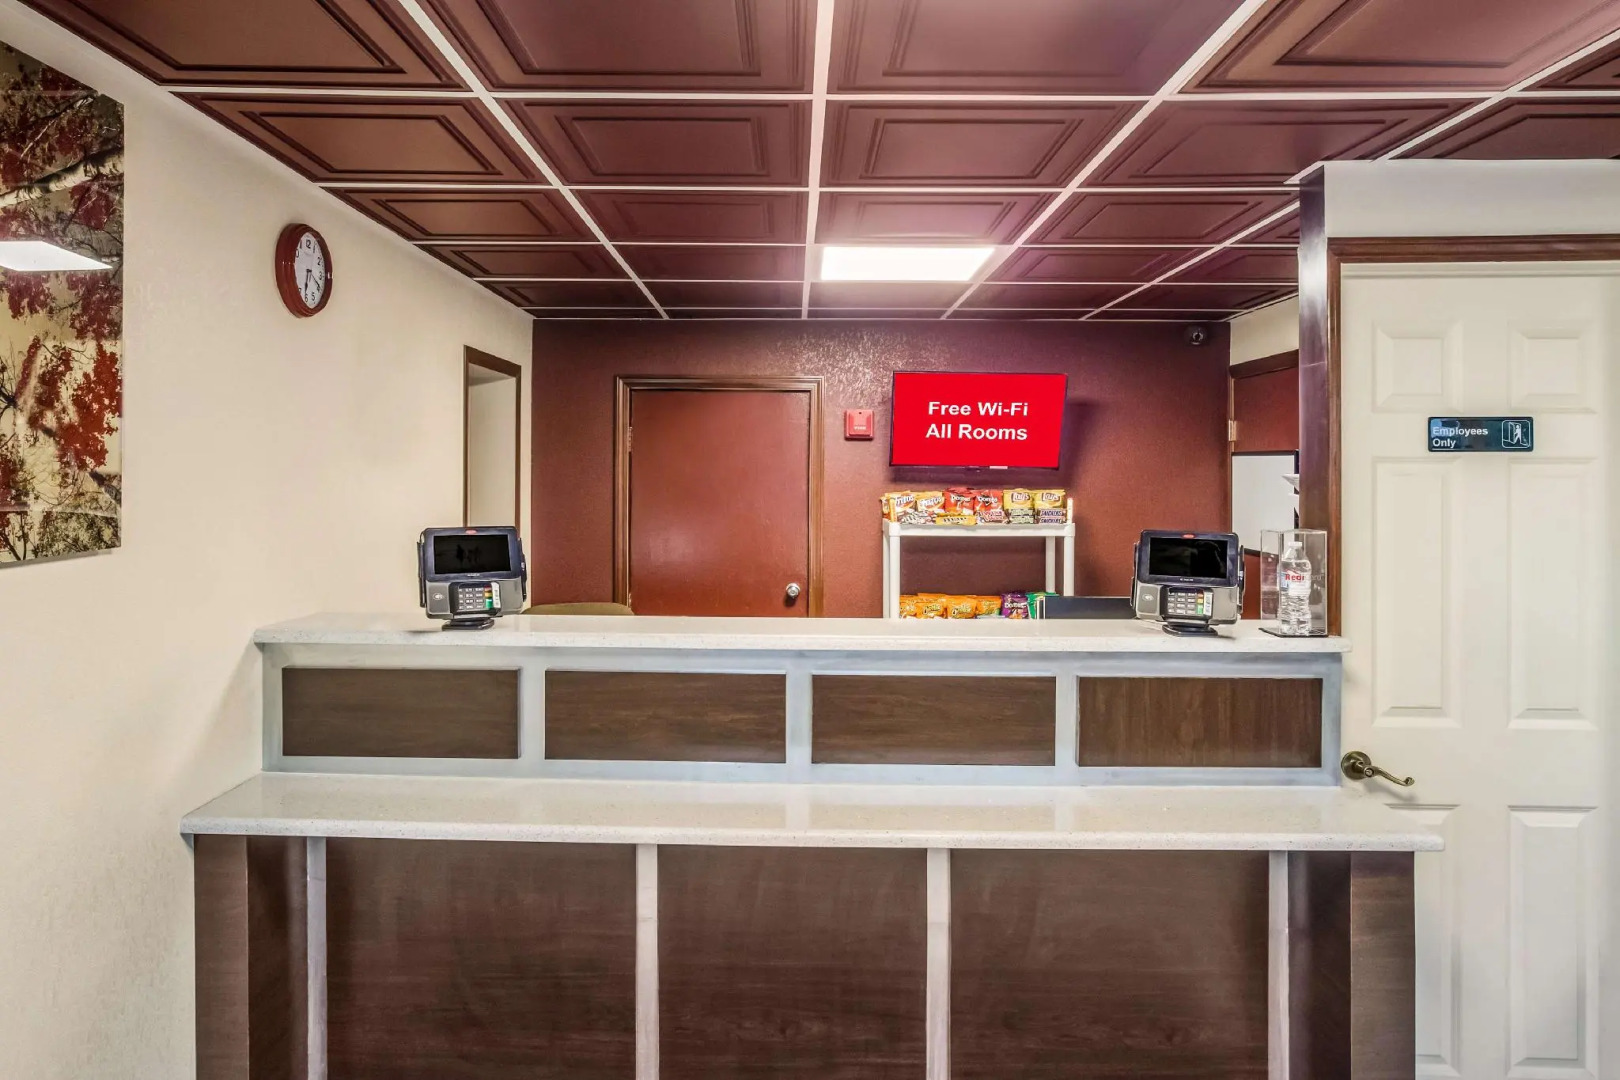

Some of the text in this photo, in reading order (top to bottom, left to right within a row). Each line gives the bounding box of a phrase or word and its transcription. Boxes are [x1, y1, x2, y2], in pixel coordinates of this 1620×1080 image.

[305, 239, 311, 249] 12
[317, 256, 322, 266] 2
[318, 271, 323, 280] 3
[928, 401, 1029, 416] Free Wi-Fi
[925, 423, 1029, 441] All Rooms
[1432, 426, 1489, 437] Employees
[1432, 438, 1457, 449] Only
